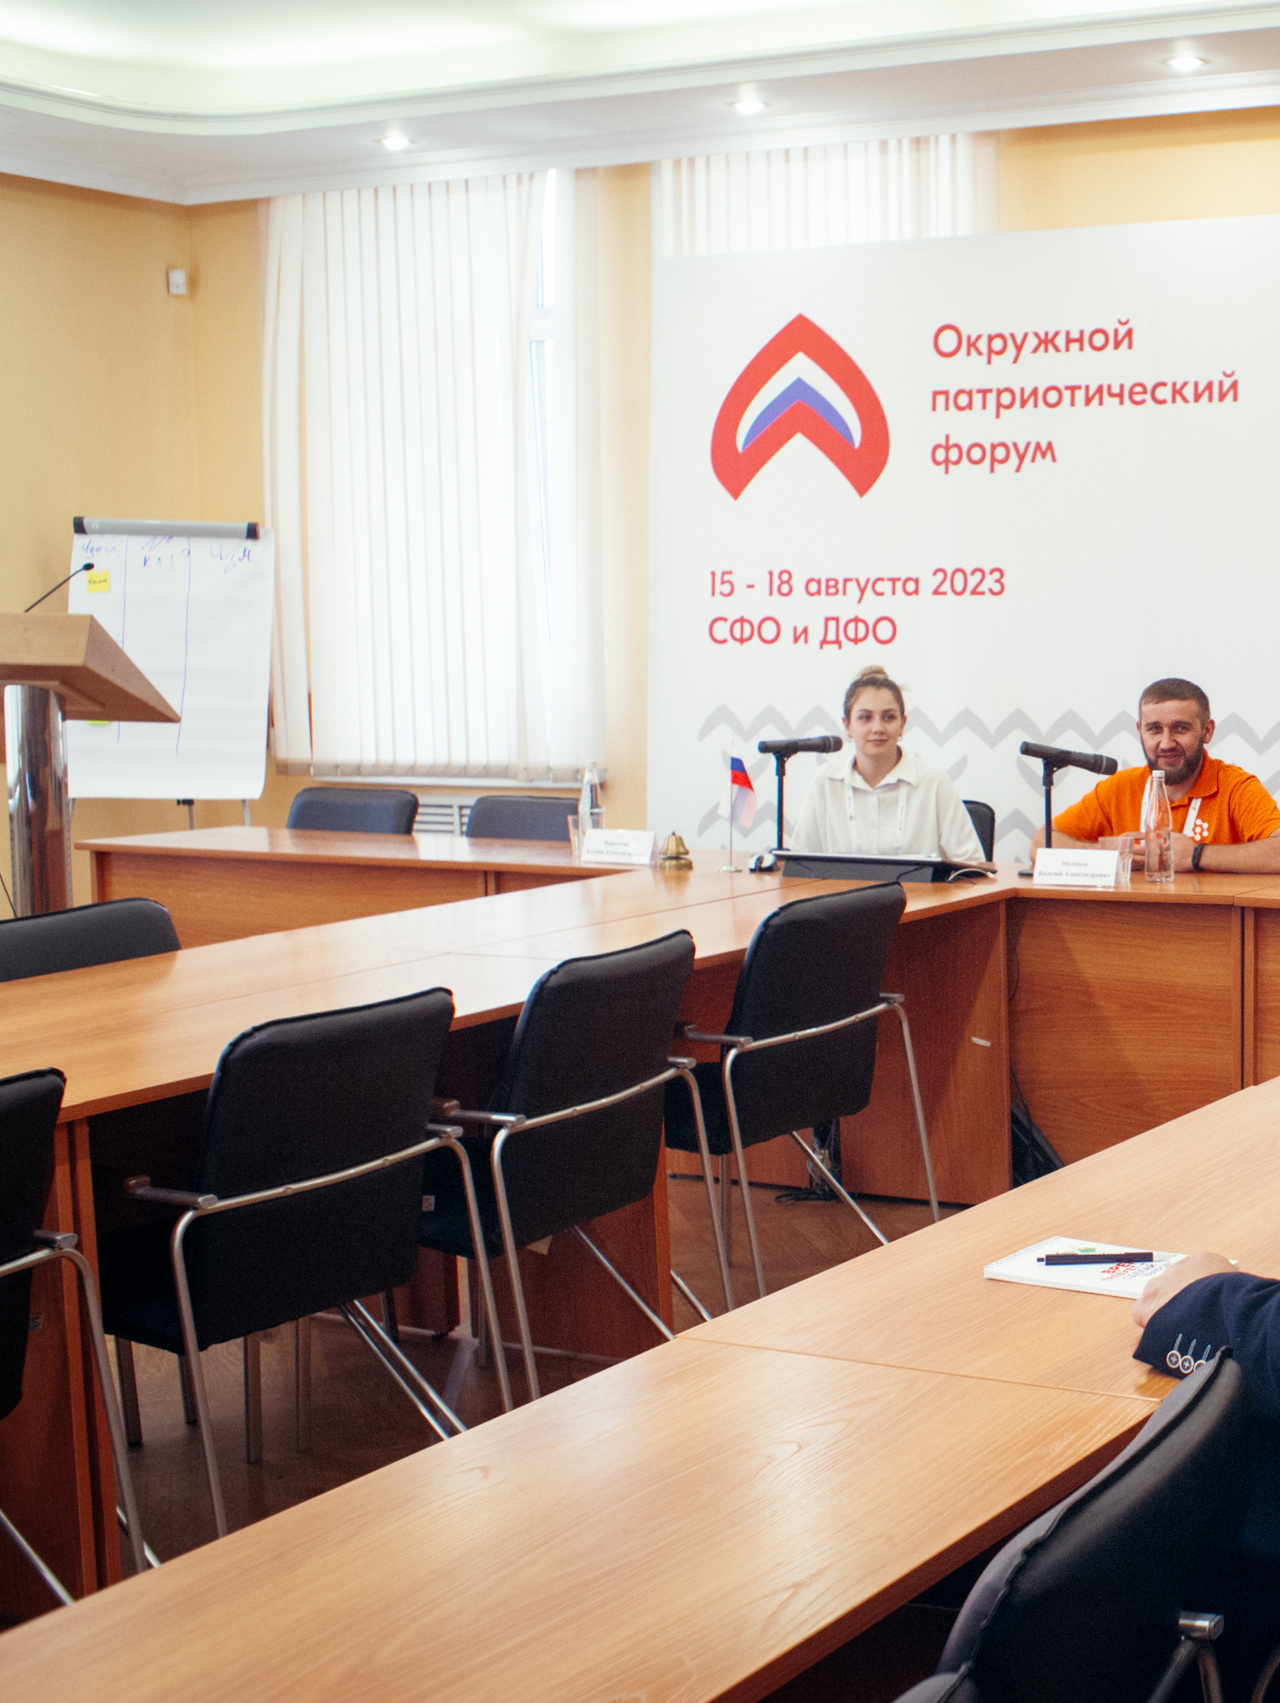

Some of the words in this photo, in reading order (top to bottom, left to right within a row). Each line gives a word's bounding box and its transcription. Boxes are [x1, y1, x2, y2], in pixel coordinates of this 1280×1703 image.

[932, 318, 1134, 366] Окружной
[931, 370, 1239, 419] патриотический
[930, 433, 1058, 475] форум
[710, 570, 735, 598] 15
[767, 569, 794, 598] 18
[804, 576, 920, 604] августа
[931, 566, 1006, 597] 2023
[708, 615, 782, 646] СФО
[792, 625, 809, 645] и
[819, 614, 898, 650] ДФО
